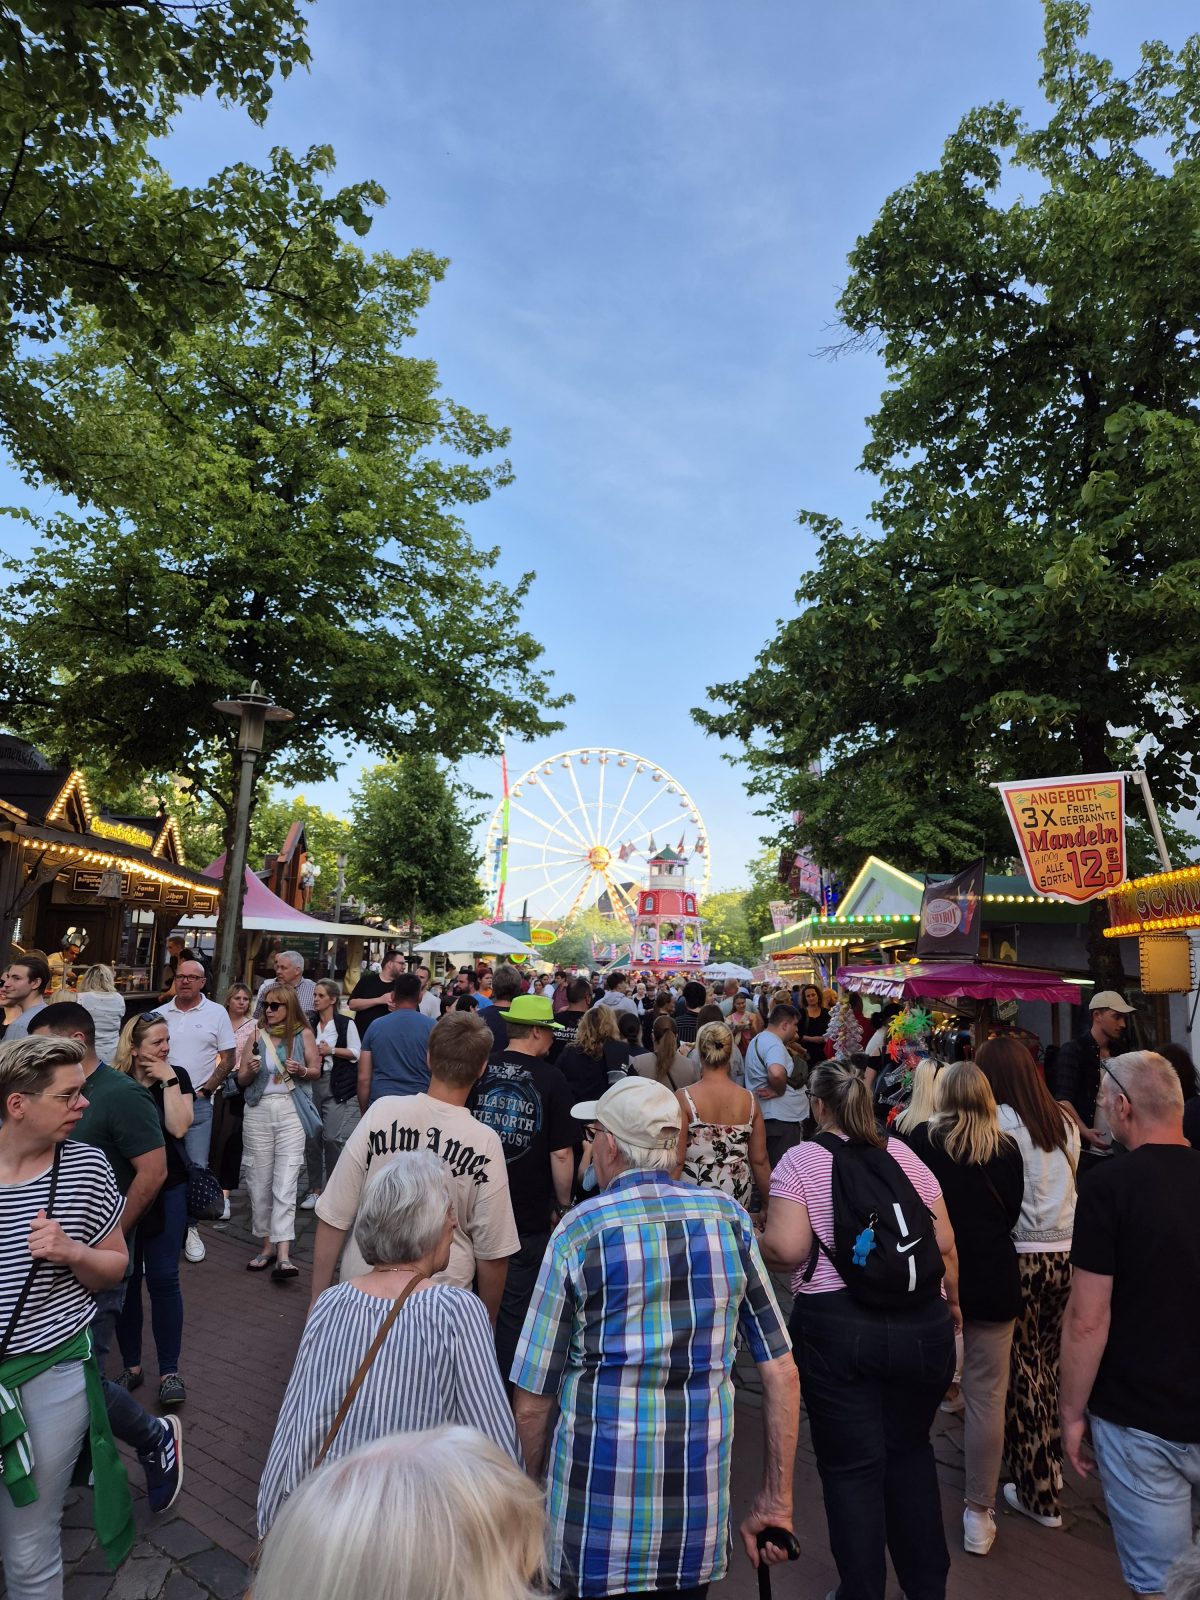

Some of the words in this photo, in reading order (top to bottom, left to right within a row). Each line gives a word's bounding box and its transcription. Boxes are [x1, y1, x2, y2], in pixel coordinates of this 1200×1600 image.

[1029, 787, 1098, 806] ANGEBOT!
[1066, 803, 1103, 815] FRISCH
[1059, 811, 1117, 827] GEBRANNTE
[1027, 822, 1119, 853] Mandeln
[1045, 861, 1065, 874] ALLE
[1040, 872, 1074, 887] SORTEN
[477, 1094, 535, 1115] BLASTING
[493, 1112, 535, 1132] NORTH
